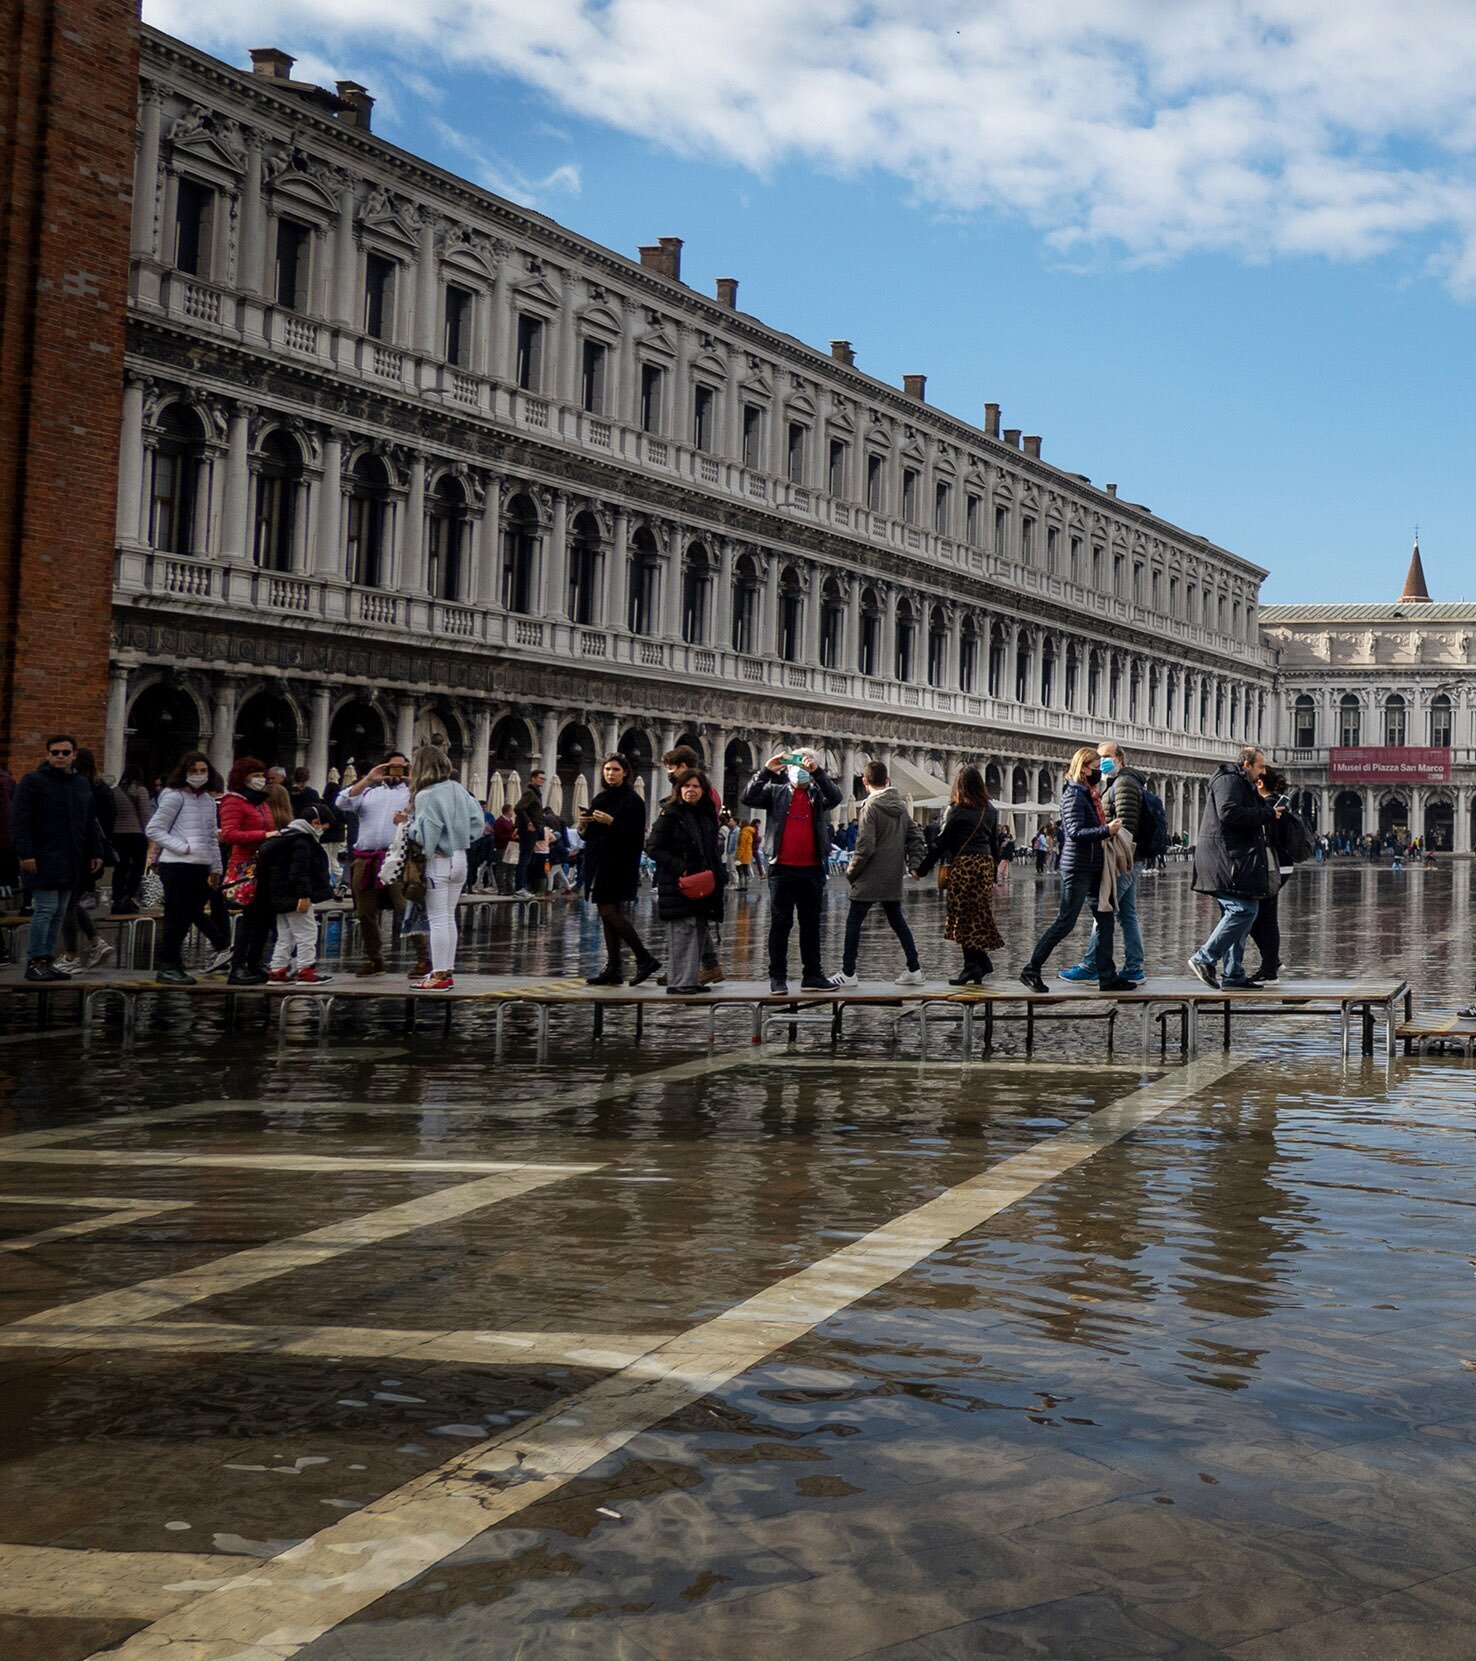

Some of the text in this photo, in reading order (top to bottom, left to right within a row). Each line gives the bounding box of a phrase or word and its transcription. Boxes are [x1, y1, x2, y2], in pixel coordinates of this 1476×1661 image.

[1337, 763, 1361, 772] Musei
[1362, 763, 1371, 772] di
[1372, 763, 1399, 772] Piazza
[1400, 763, 1416, 772] San
[1418, 763, 1444, 772] Marco
